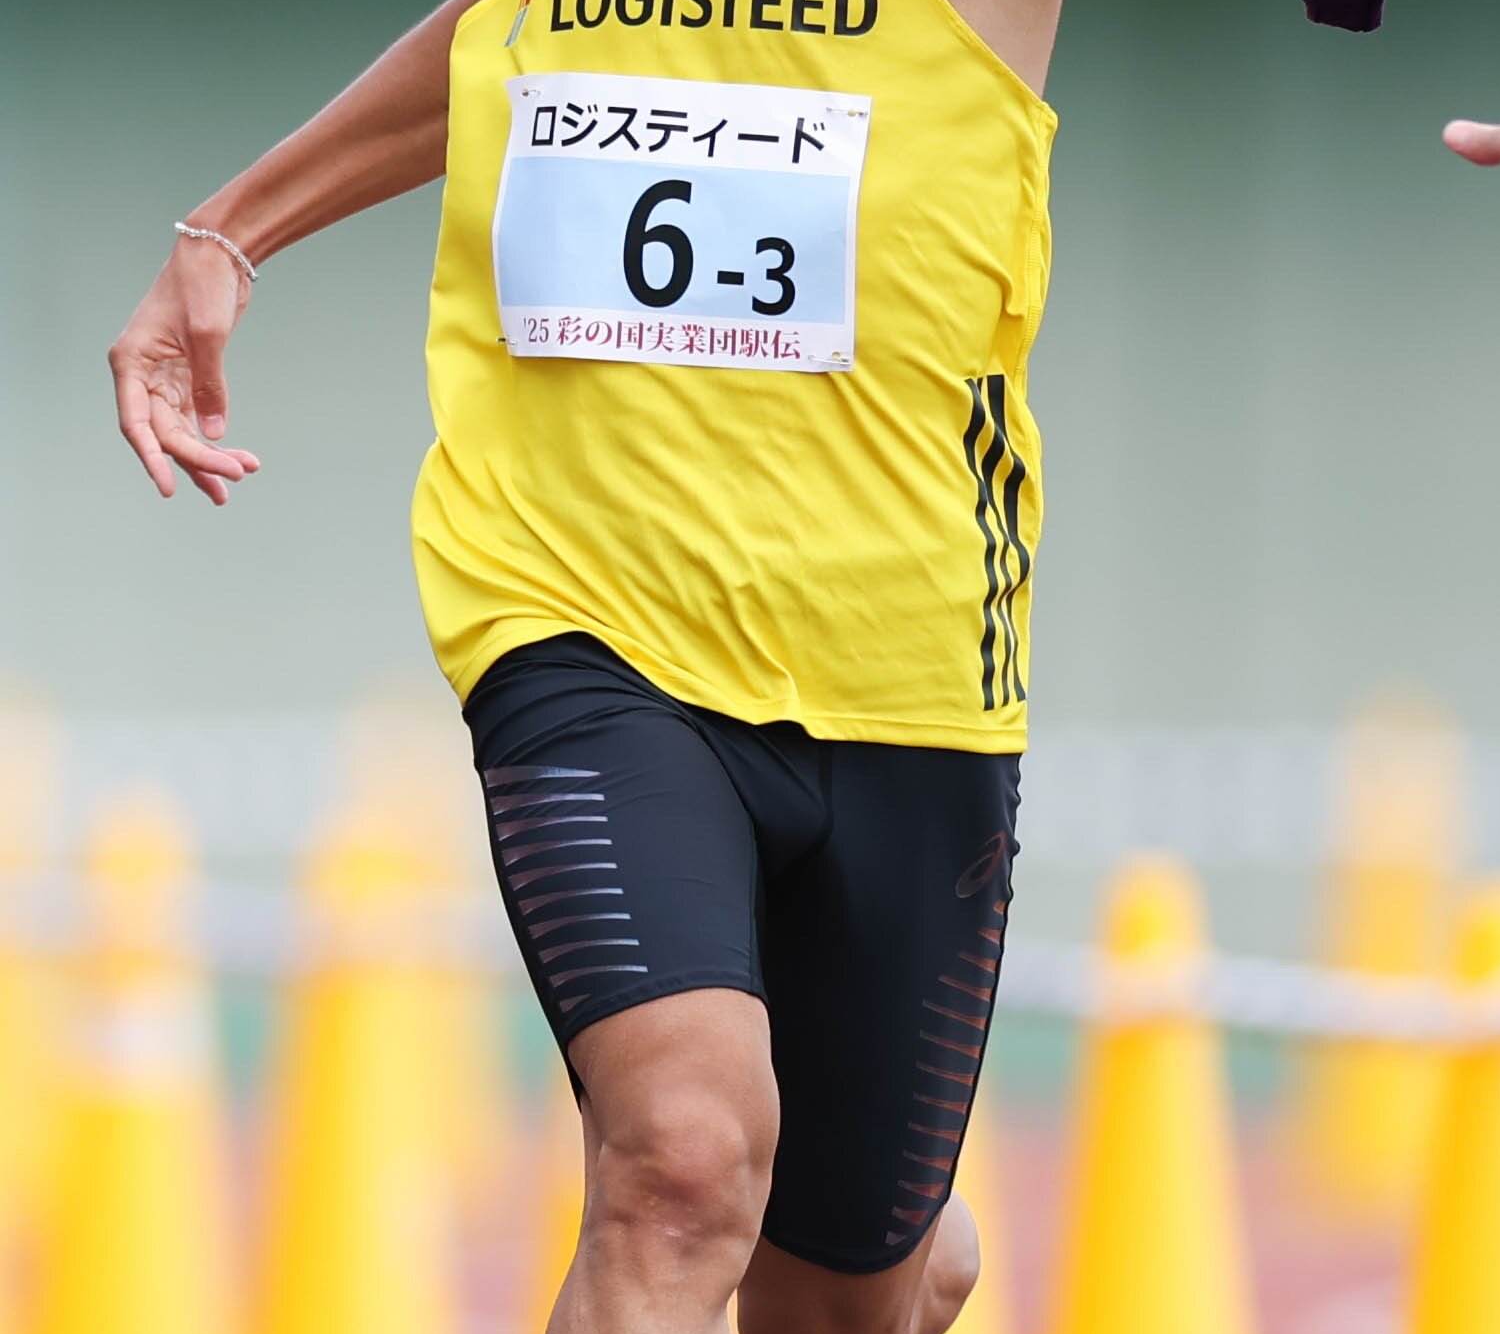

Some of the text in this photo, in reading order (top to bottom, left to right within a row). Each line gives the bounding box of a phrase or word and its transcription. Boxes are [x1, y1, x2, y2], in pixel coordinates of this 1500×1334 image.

[531, 102, 826, 164] ロジスティード
